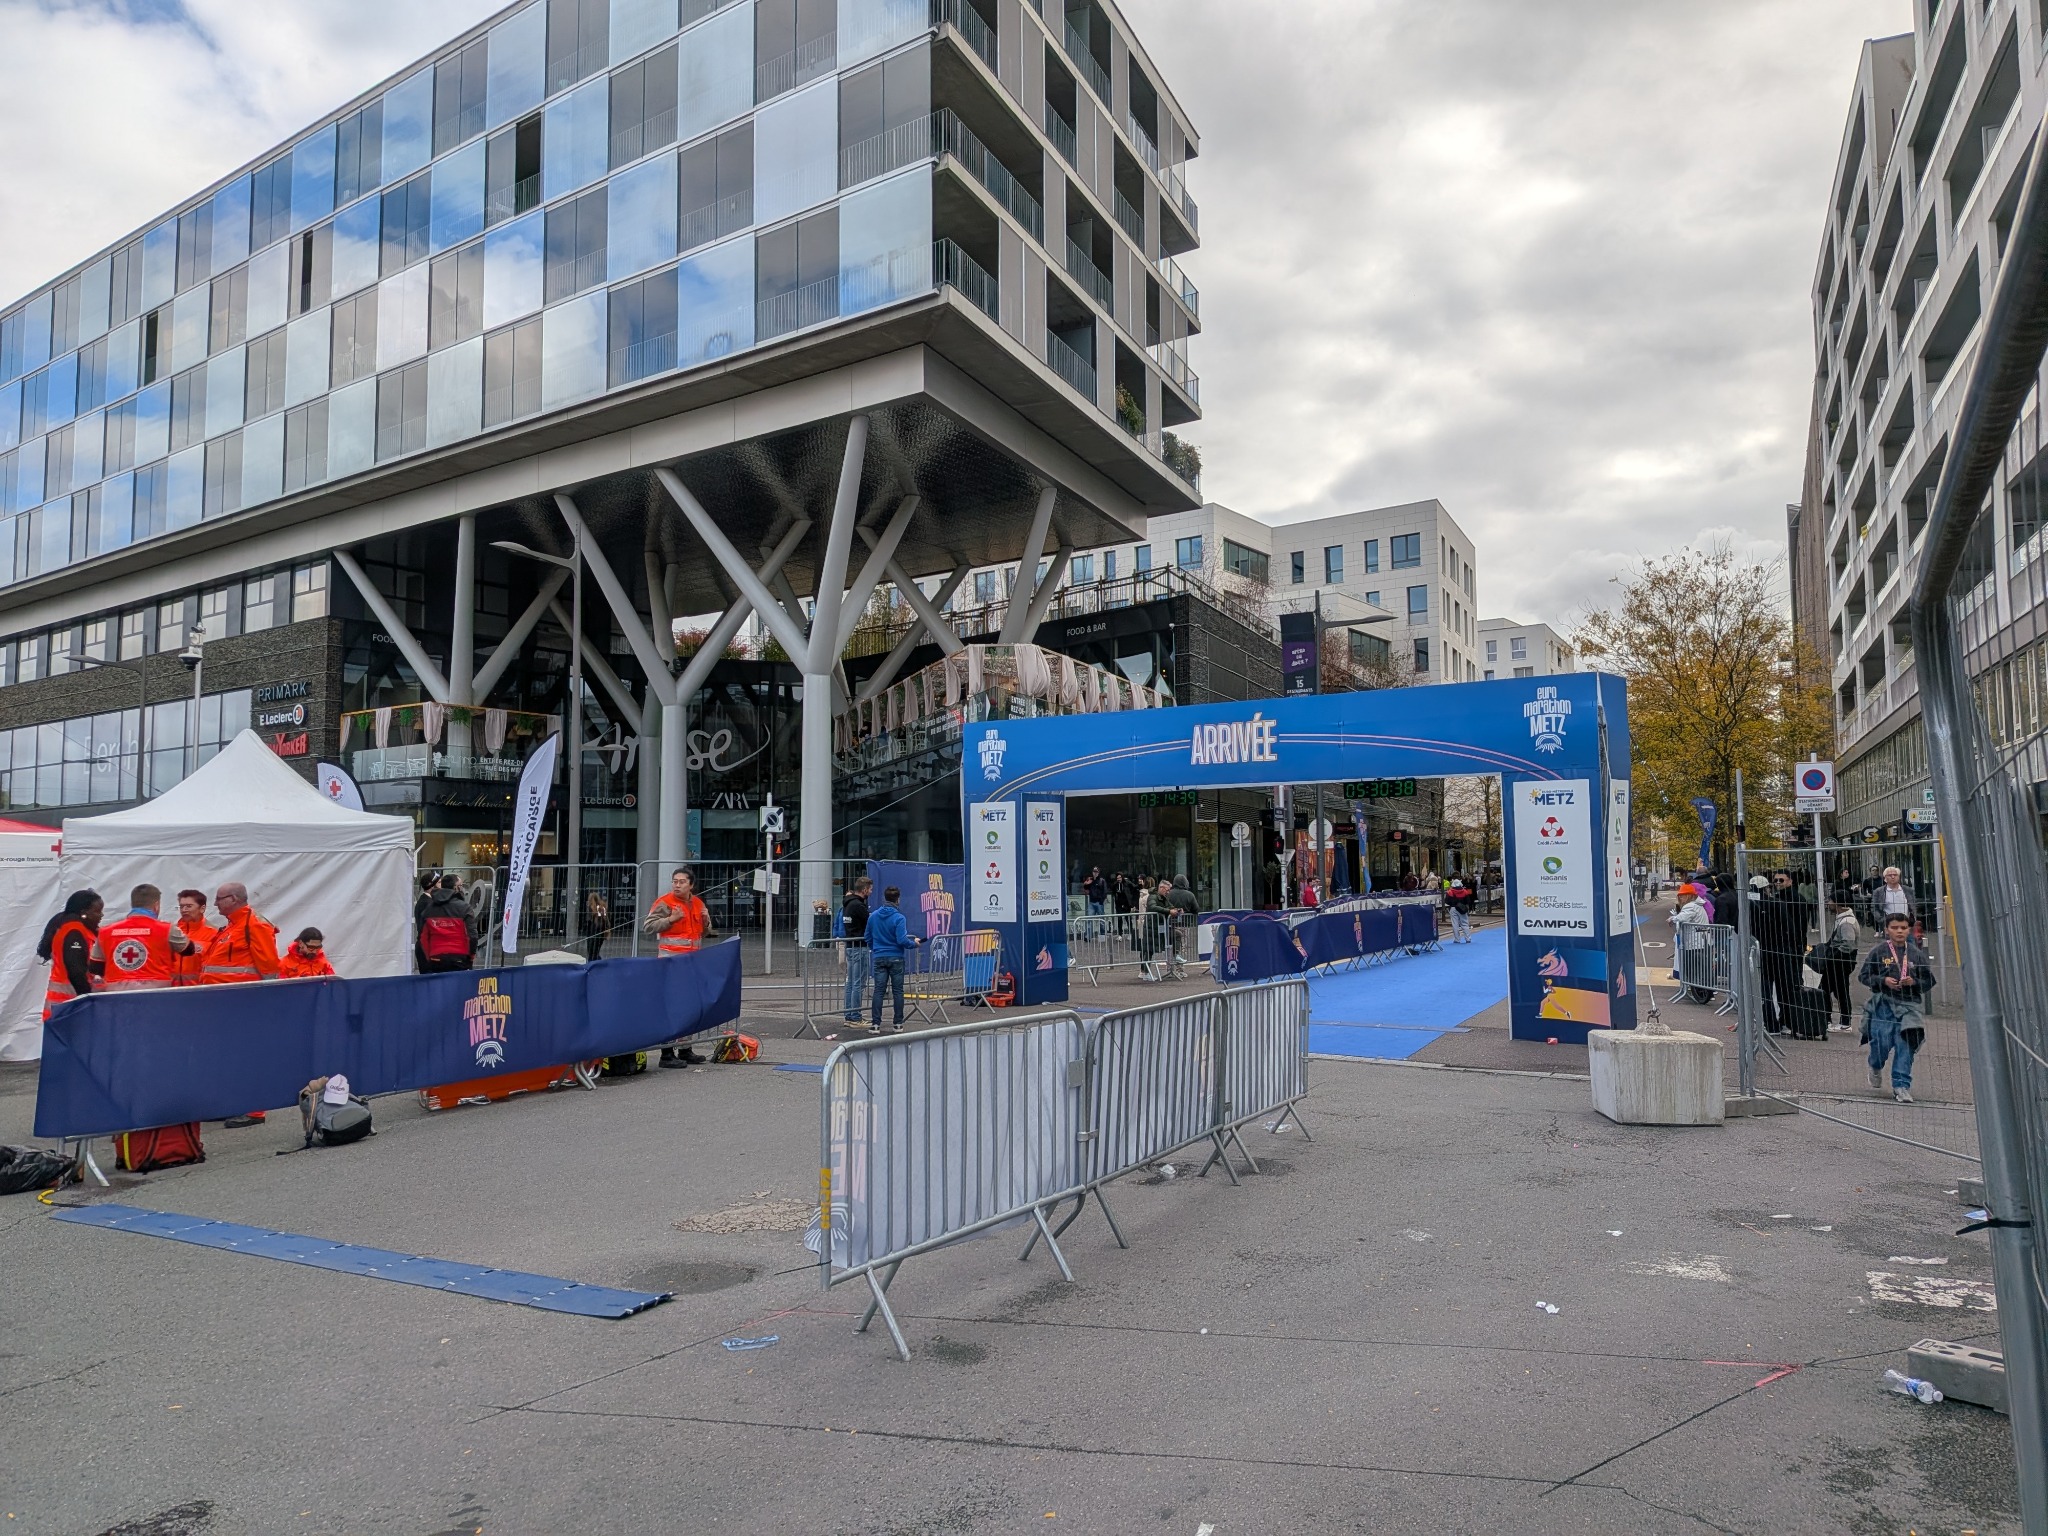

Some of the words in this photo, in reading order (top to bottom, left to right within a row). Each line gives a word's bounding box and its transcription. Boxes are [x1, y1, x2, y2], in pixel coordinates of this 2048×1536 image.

[1066, 626, 1086, 637] FOOD
[1086, 625, 1092, 633] &
[1092, 622, 1107, 632] BAR
[258, 681, 307, 701] PRIMARK
[1295, 679, 1305, 689] 15
[1536, 686, 1558, 701] euro
[1523, 699, 1572, 719] marathon
[1529, 713, 1567, 738] METZ
[985, 729, 999, 740] euro
[1190, 711, 1278, 766] ARRIVÉE
[275, 732, 306, 757] YORKER
[977, 739, 1007, 754] marathon
[981, 750, 1004, 769] METZ
[1346, 780, 1414, 798] 05:30:38
[711, 792, 750, 809] ZARA
[1140, 791, 1197, 807] 03:14:39
[1534, 792, 1575, 806] METZ
[982, 811, 1007, 822] METZ
[1035, 812, 1054, 822] METZ
[928, 873, 944, 890] euro
[920, 890, 956, 913] marathon
[1539, 895, 1558, 903] METZ
[1030, 907, 1060, 917] CAMPUS
[926, 909, 952, 940] METZ
[1523, 919, 1589, 930] CAMPUS
[477, 976, 498, 996] euro
[462, 994, 512, 1021] marathon
[469, 1013, 508, 1047] METZ
